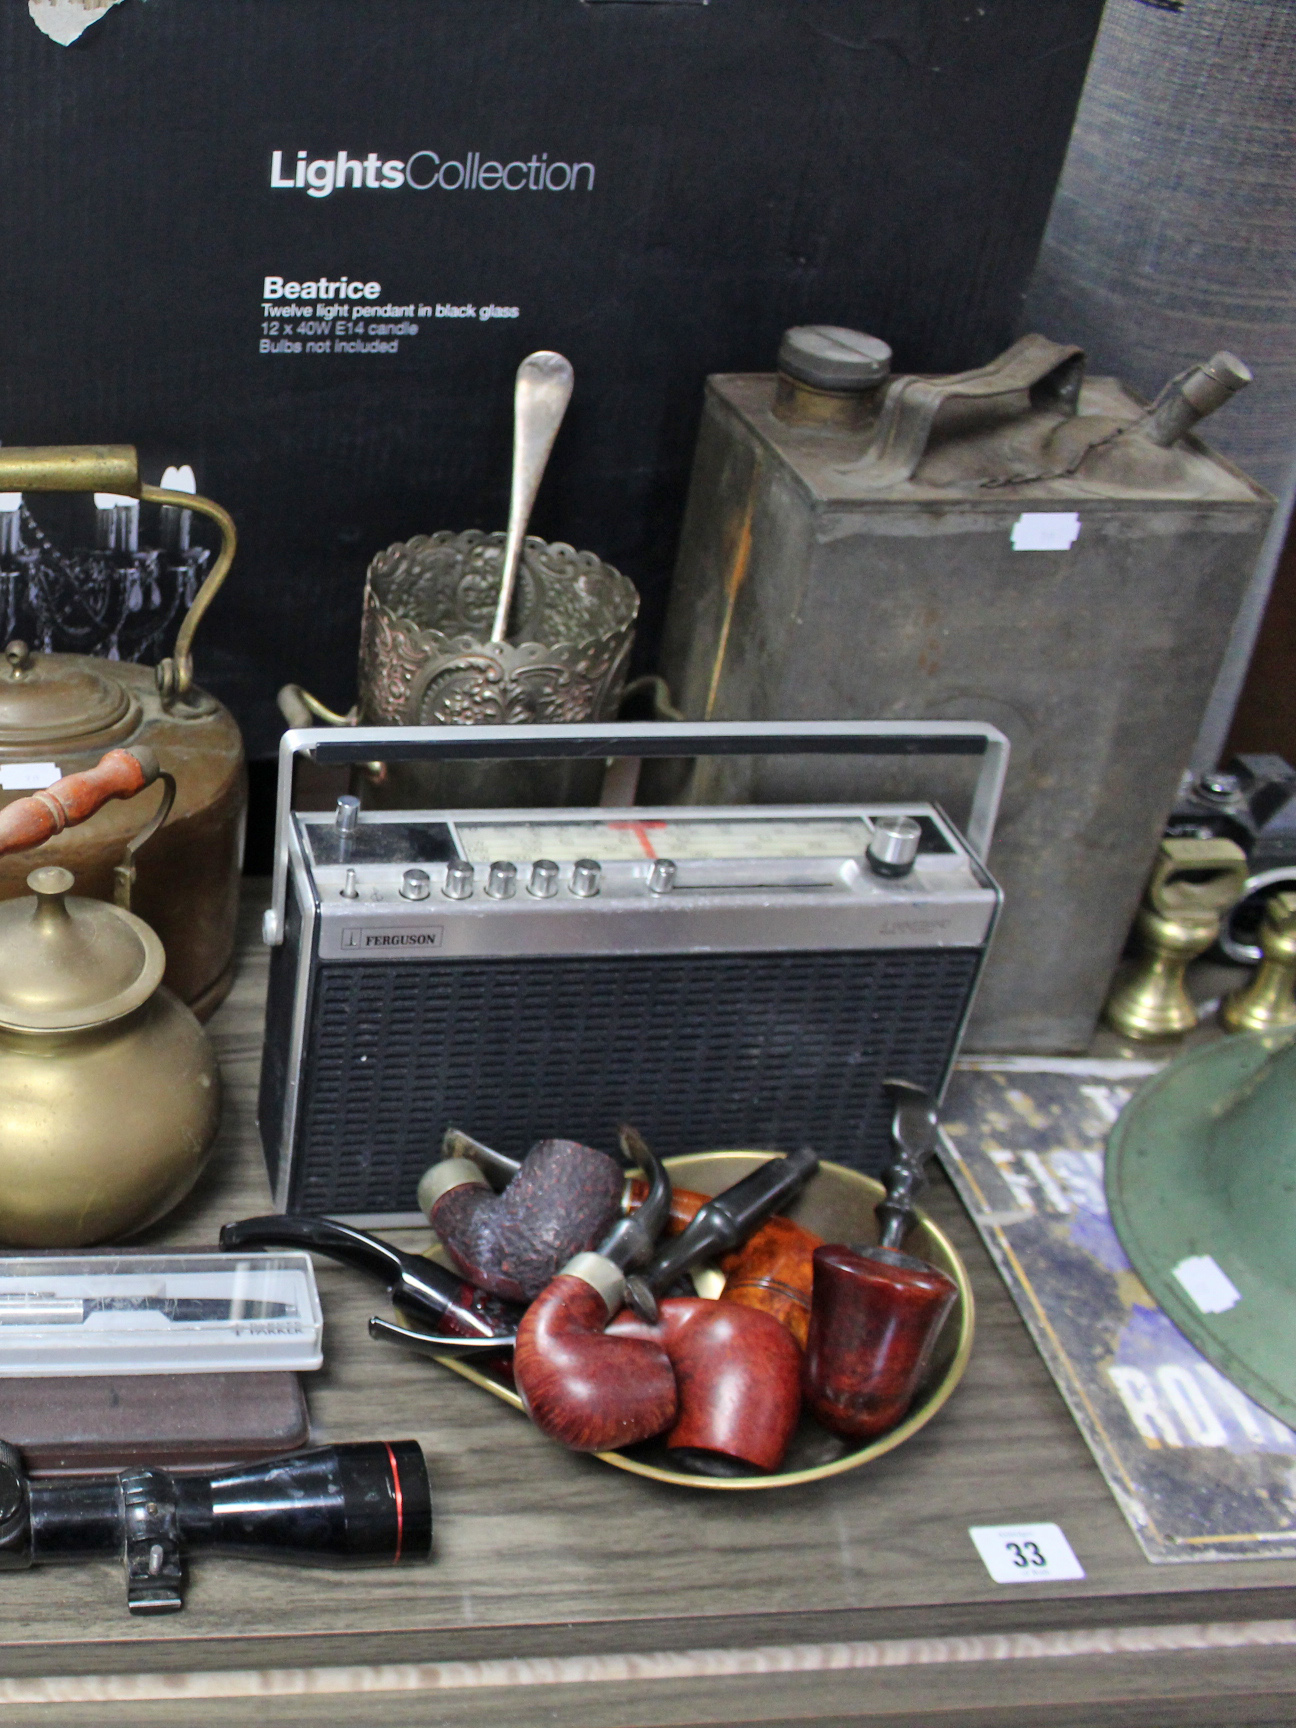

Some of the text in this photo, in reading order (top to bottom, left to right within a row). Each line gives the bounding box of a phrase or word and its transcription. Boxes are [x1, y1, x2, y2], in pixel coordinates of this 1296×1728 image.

[269, 149, 596, 198] LightsCollection
[262, 276, 382, 300] Beatrice
[260, 303, 520, 321] Twelve light pendant in black glass
[261, 321, 420, 336] 12 x 40W E14 candle
[259, 339, 400, 353] Bulbs not included
[365, 933, 436, 946] FERGUSON
[1005, 1541, 1048, 1568] 33
